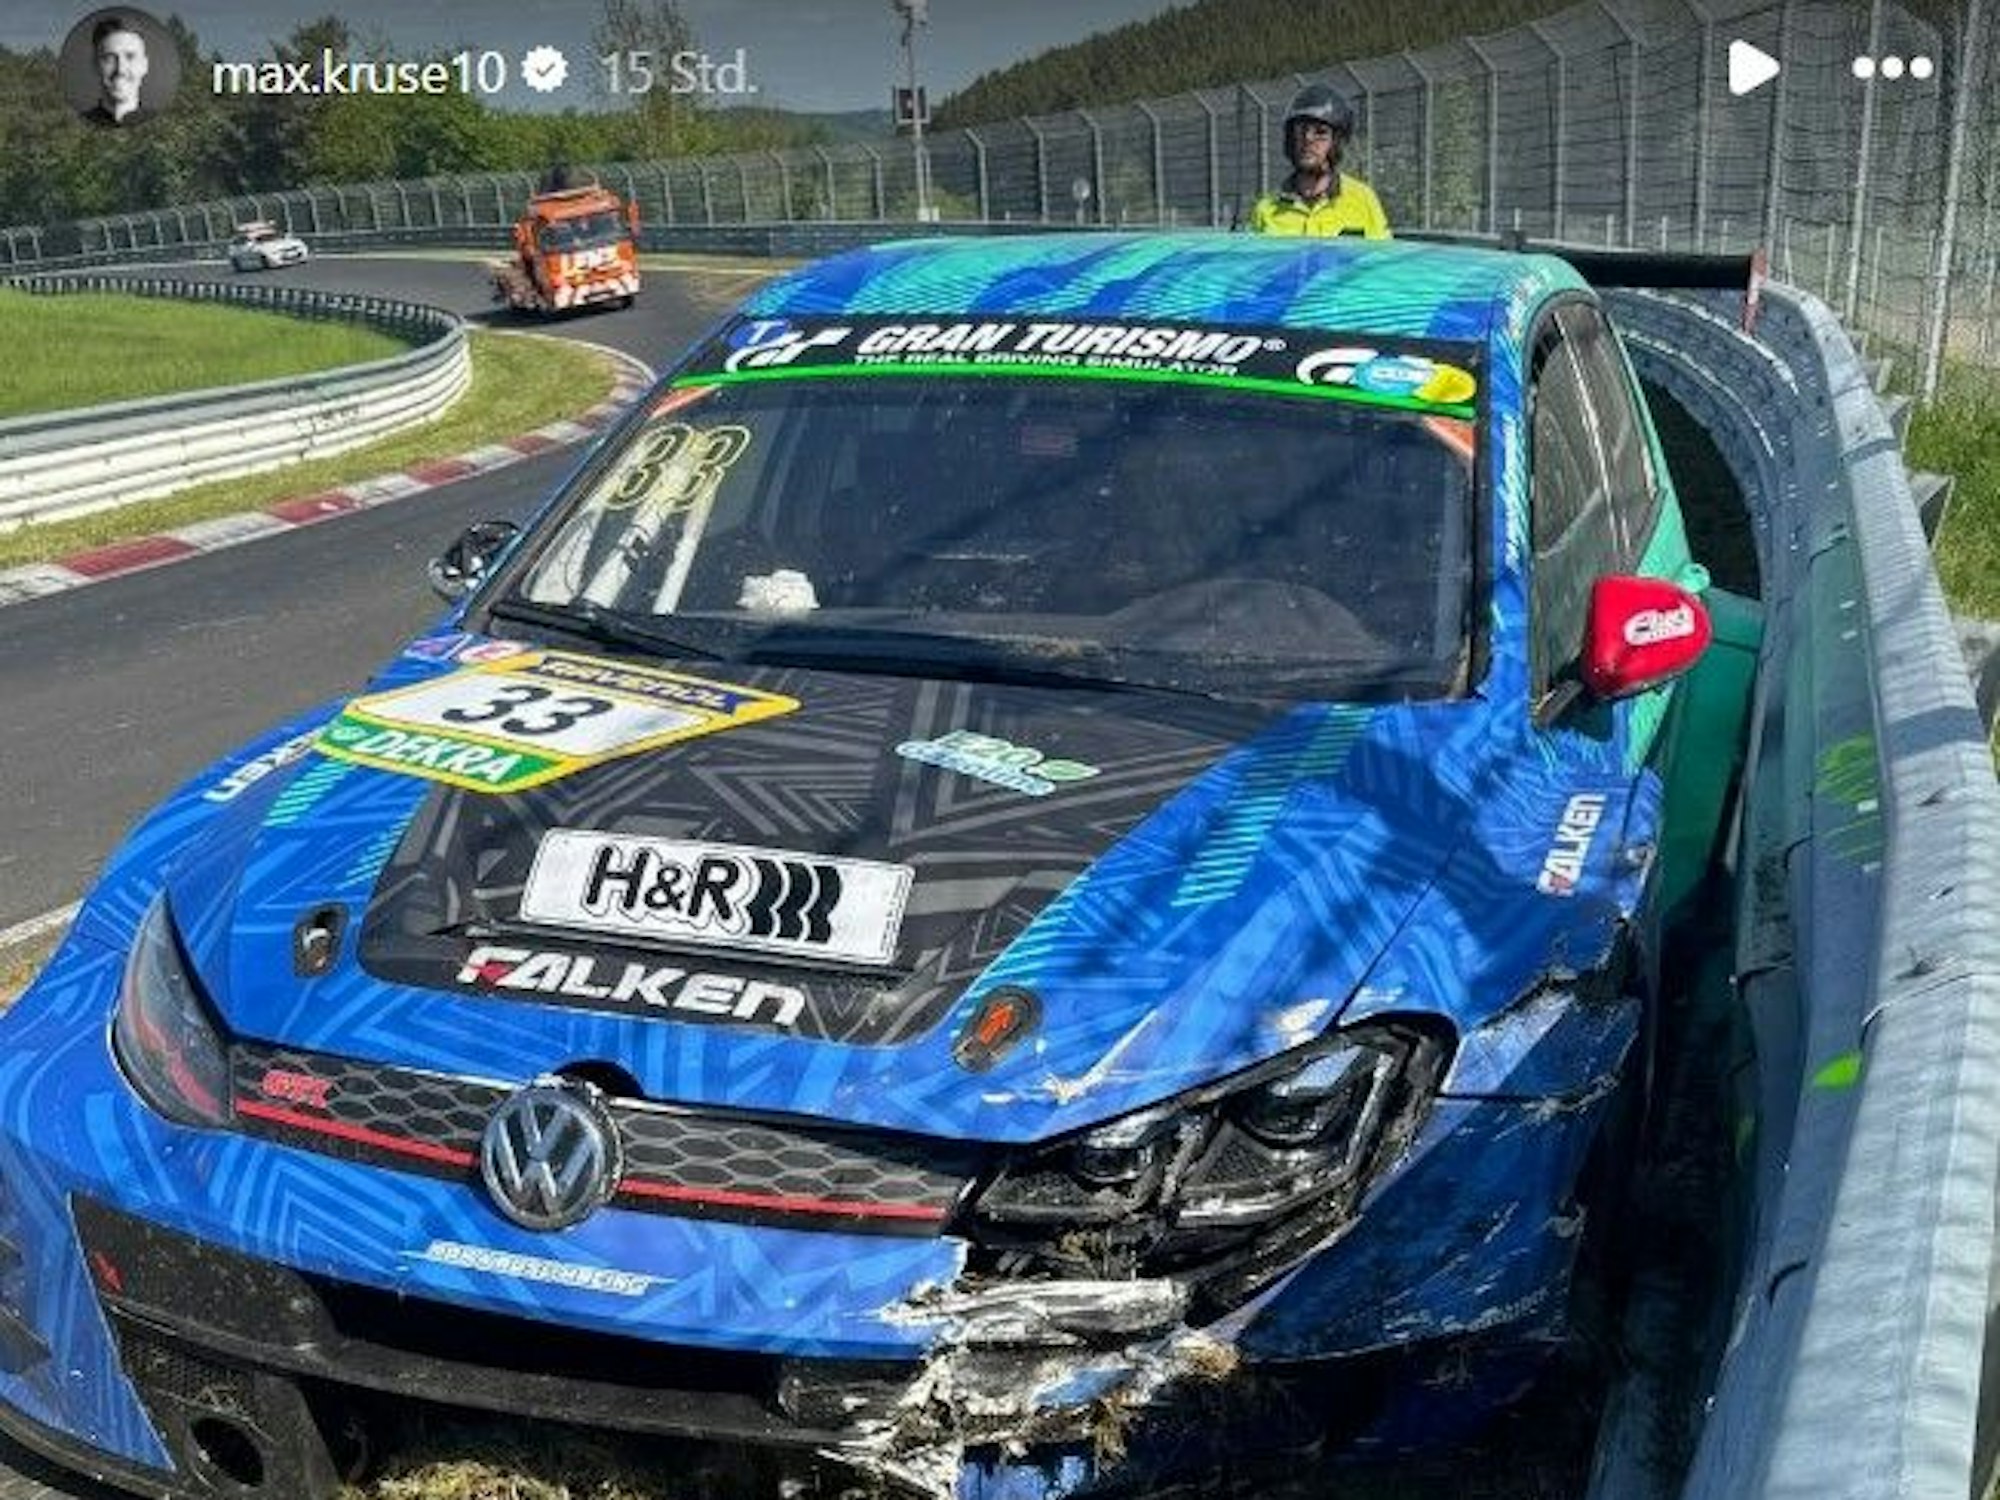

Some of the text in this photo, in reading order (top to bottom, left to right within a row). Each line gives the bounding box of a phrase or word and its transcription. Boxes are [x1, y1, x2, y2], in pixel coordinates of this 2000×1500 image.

[855, 352, 1238, 377] THE REAL DRIVING SIMULATOR
[857, 323, 1017, 354] GRAN
[441, 685, 614, 736] 33
[351, 730, 522, 784] DEKRA
[1535, 792, 1607, 897] FALKEN
[584, 846, 740, 922] H&R
[456, 946, 805, 1027] FALKEN
